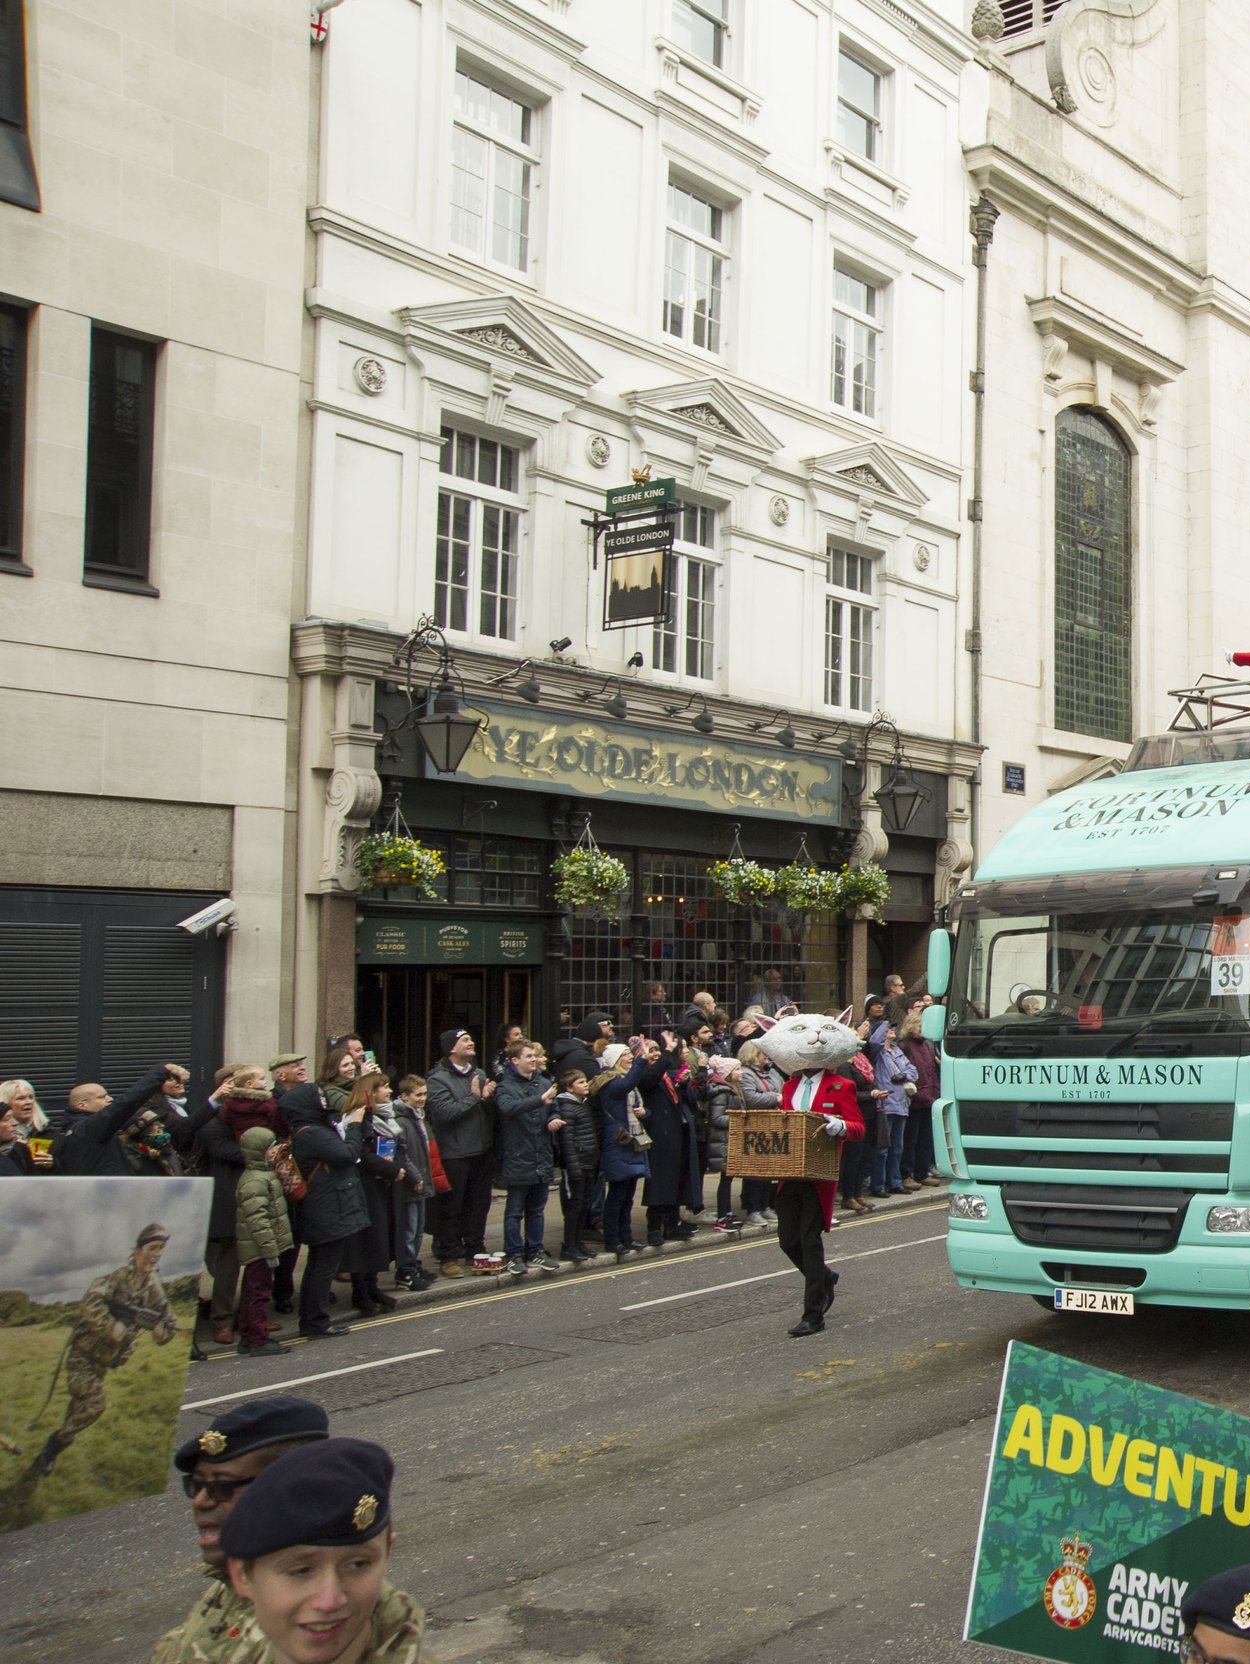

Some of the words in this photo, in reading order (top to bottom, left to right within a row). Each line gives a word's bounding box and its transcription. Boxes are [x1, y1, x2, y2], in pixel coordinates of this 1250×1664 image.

[611, 491, 643, 505] GREENE
[643, 488, 665, 499] KING
[606, 539, 617, 547] YE
[616, 535, 636, 545] OLDE
[636, 529, 670, 542] LONDON
[487, 722, 541, 767] YE
[555, 734, 654, 783] OLDE
[667, 752, 800, 802] LONDON
[1085, 829, 1123, 840] EST
[1129, 825, 1171, 836] 1707
[376, 943, 388, 951] PUB
[388, 943, 407, 951] FOOD
[500, 939, 527, 948] SPIRITS
[1218, 962, 1244, 987] 39
[981, 1065, 1090, 1085] FORTNUM
[1095, 1064, 1111, 1085] &
[1117, 1064, 1204, 1085] MASON
[1061, 1090, 1082, 1099] EST
[1088, 1090, 1111, 1099] 1707
[742, 1131, 791, 1155] F&M
[1066, 1292, 1097, 1309] FJ12
[1101, 1295, 1128, 1312] AWX
[1108, 1563, 1189, 1608] ARMY
[1058, 1566, 1089, 1581] CADET
[1080, 1588, 1096, 1626] FORCE
